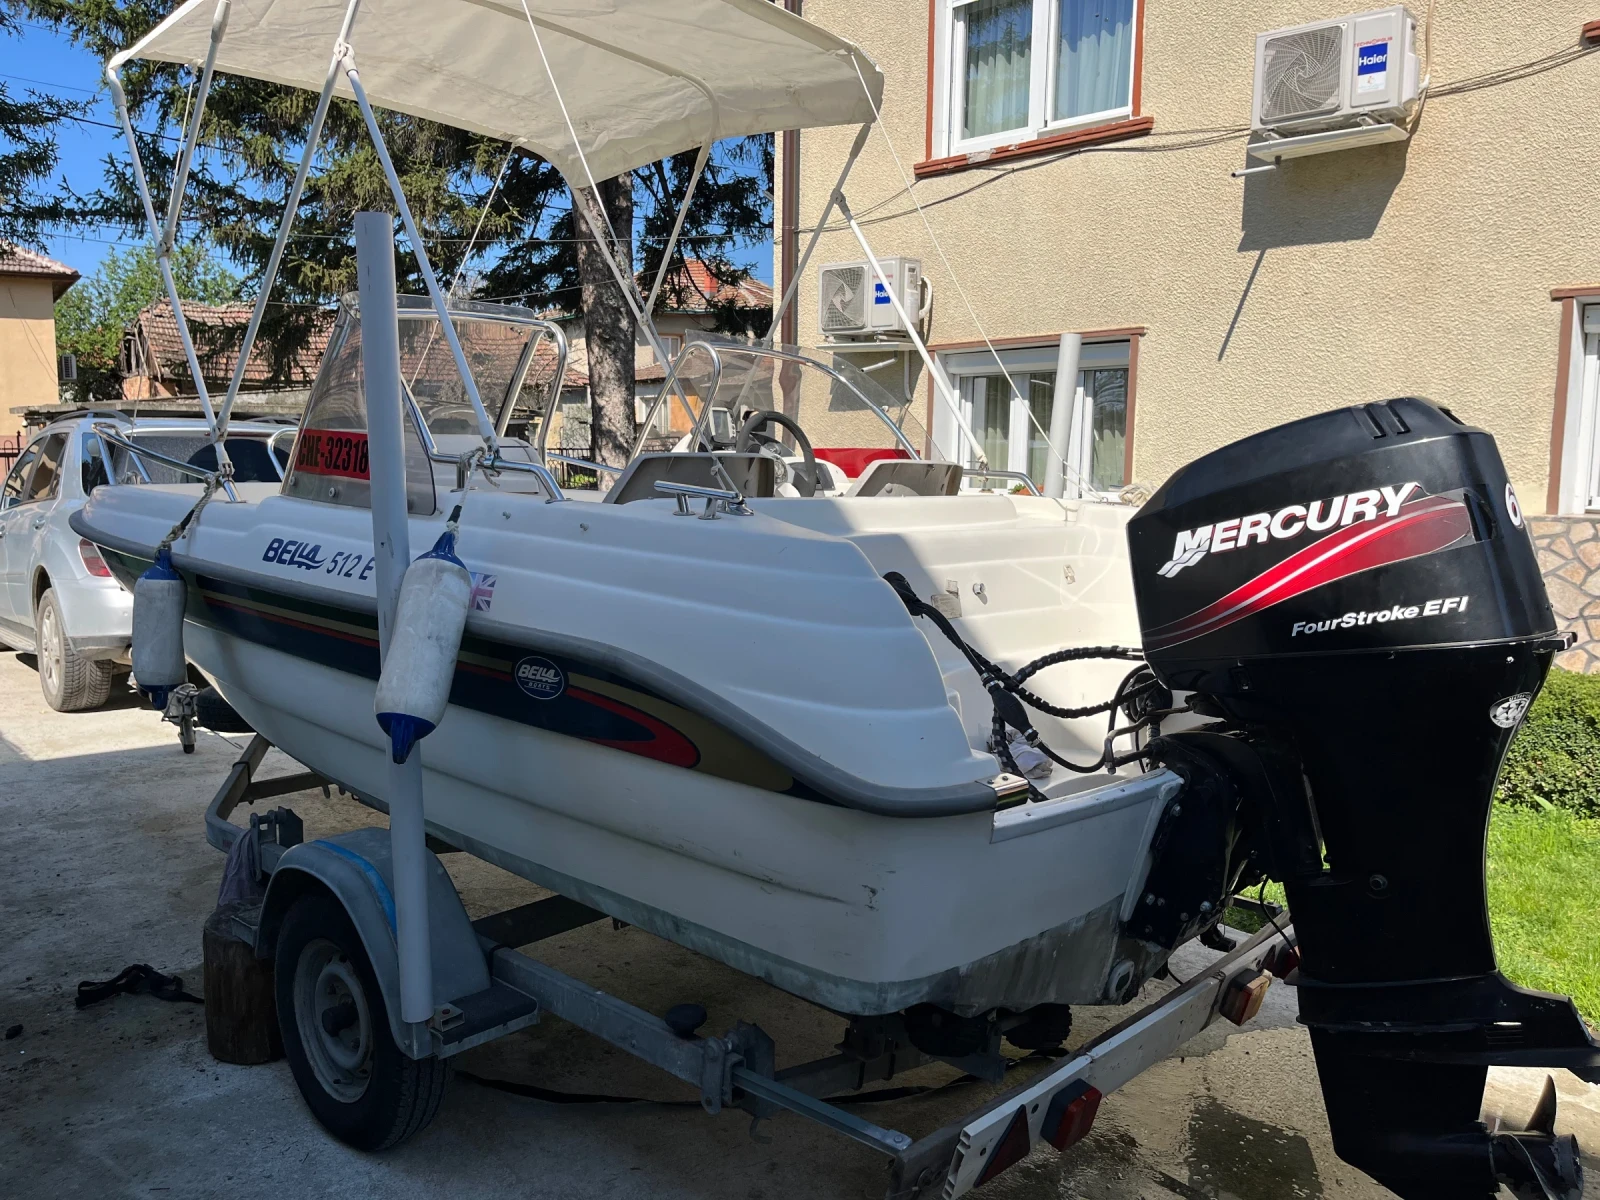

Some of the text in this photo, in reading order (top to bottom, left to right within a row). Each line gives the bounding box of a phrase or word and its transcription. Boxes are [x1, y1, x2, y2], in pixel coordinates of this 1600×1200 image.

[1359, 54, 1387, 67] Haier
[1157, 481, 1421, 578] MERCURY
[262, 538, 328, 570] BELLA
[326, 551, 363, 578] 512
[1292, 596, 1469, 637] FourStroke EFI
[518, 664, 560, 682] BELLA
